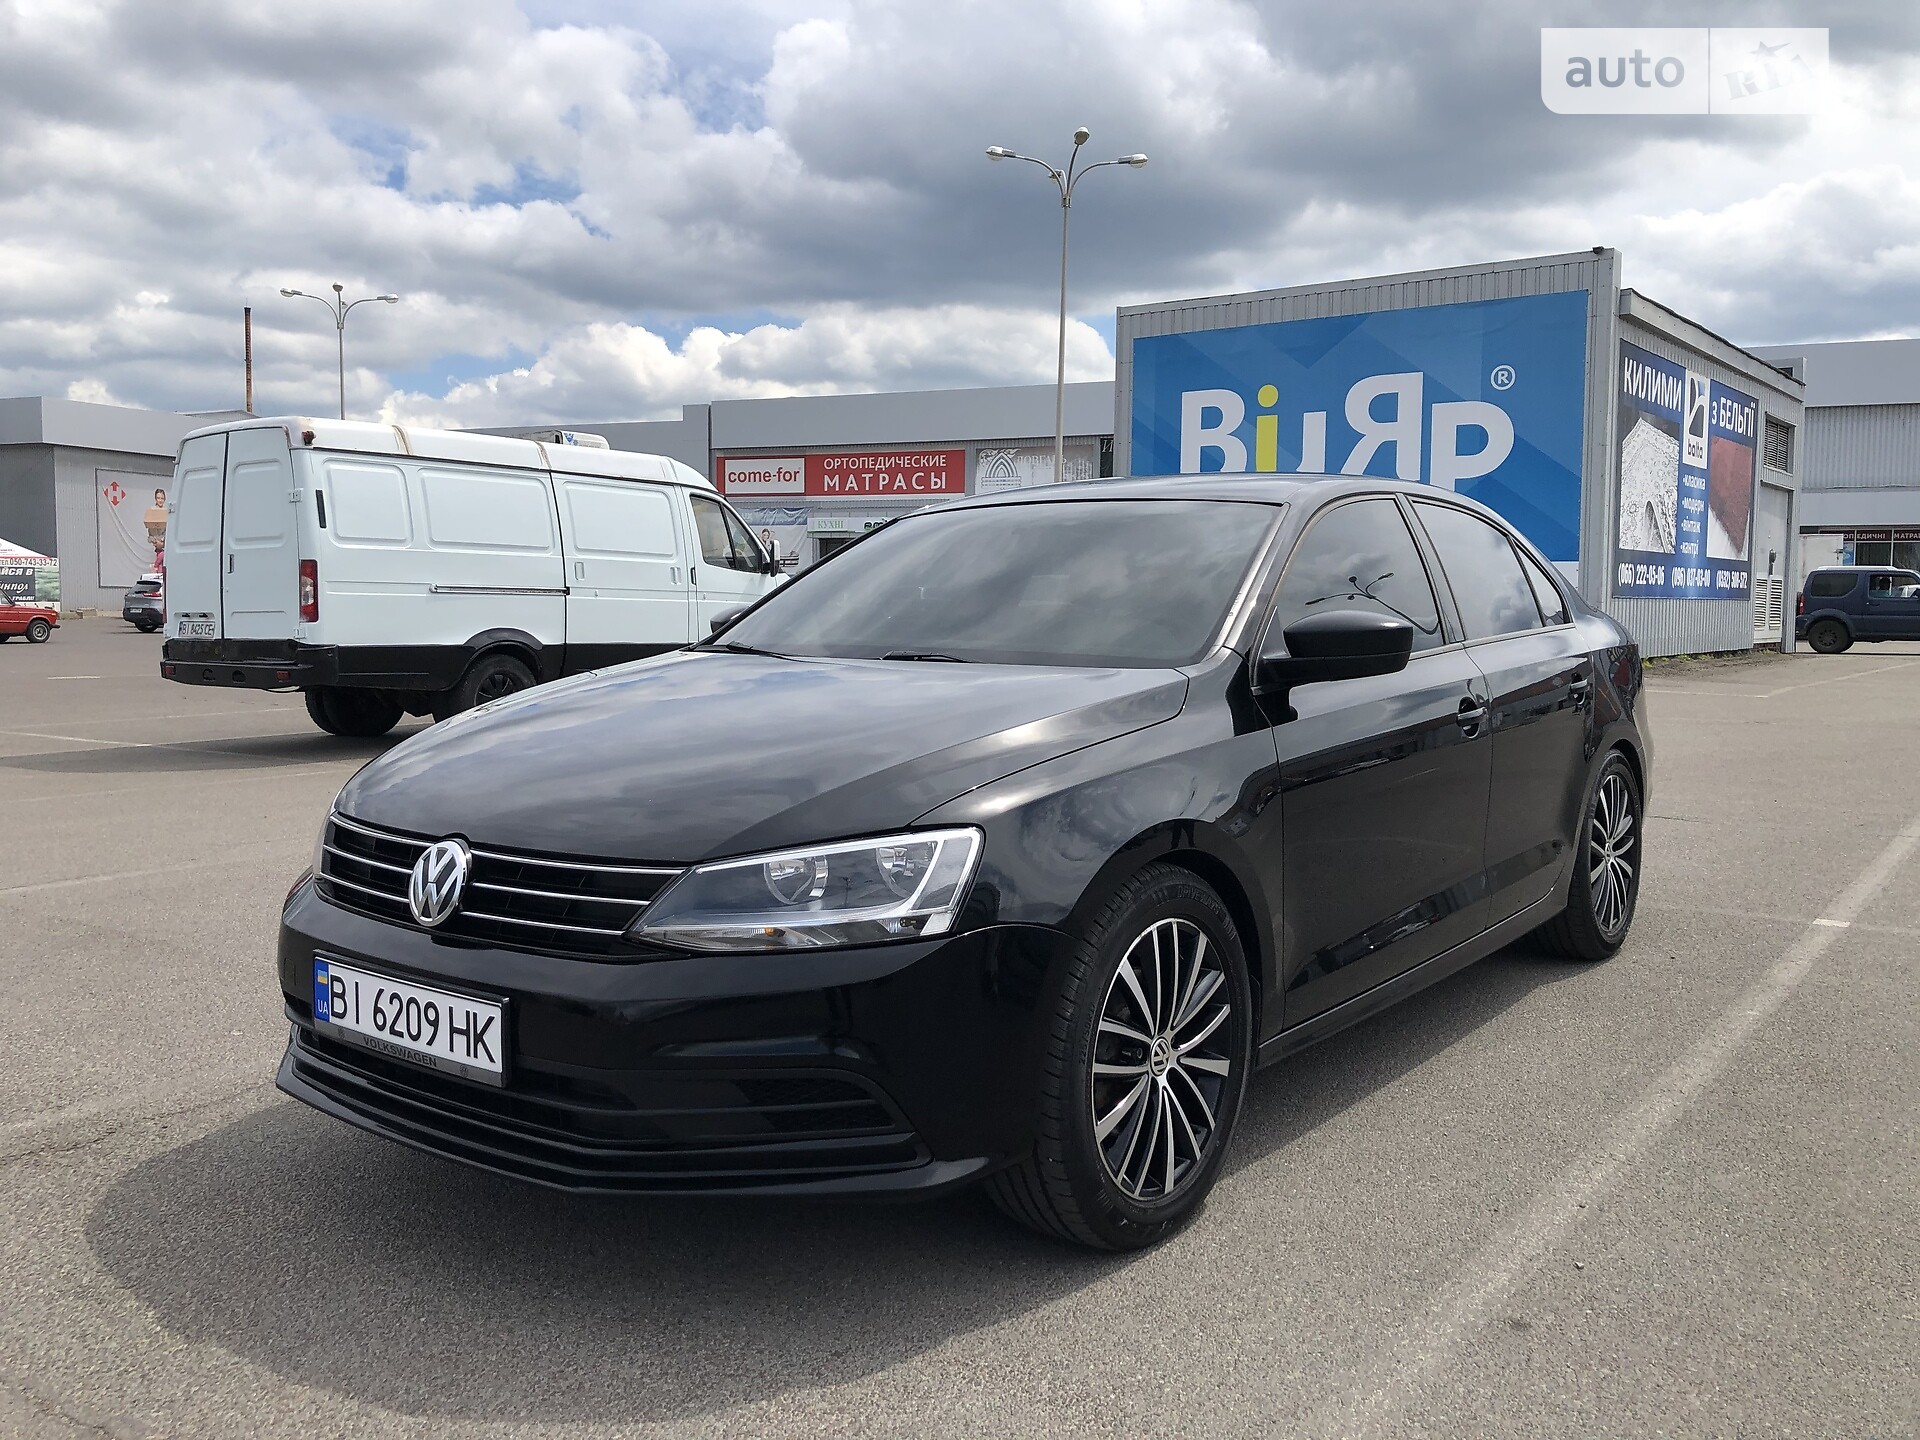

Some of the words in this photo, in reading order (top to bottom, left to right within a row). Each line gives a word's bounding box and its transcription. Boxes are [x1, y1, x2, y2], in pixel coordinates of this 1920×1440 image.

[1623, 356, 1682, 413] КИЛИМИ
[823, 455, 947, 471] ОРТОПЕДИЧЕСКИЕ
[727, 466, 800, 483] come-for
[823, 471, 947, 492] МАТРАСЫ
[317, 999, 329, 1015] UA
[330, 973, 360, 1025] BI
[372, 987, 440, 1047] 6209
[448, 1005, 496, 1064] HK
[363, 1035, 437, 1068] VOLKSWAGEN
